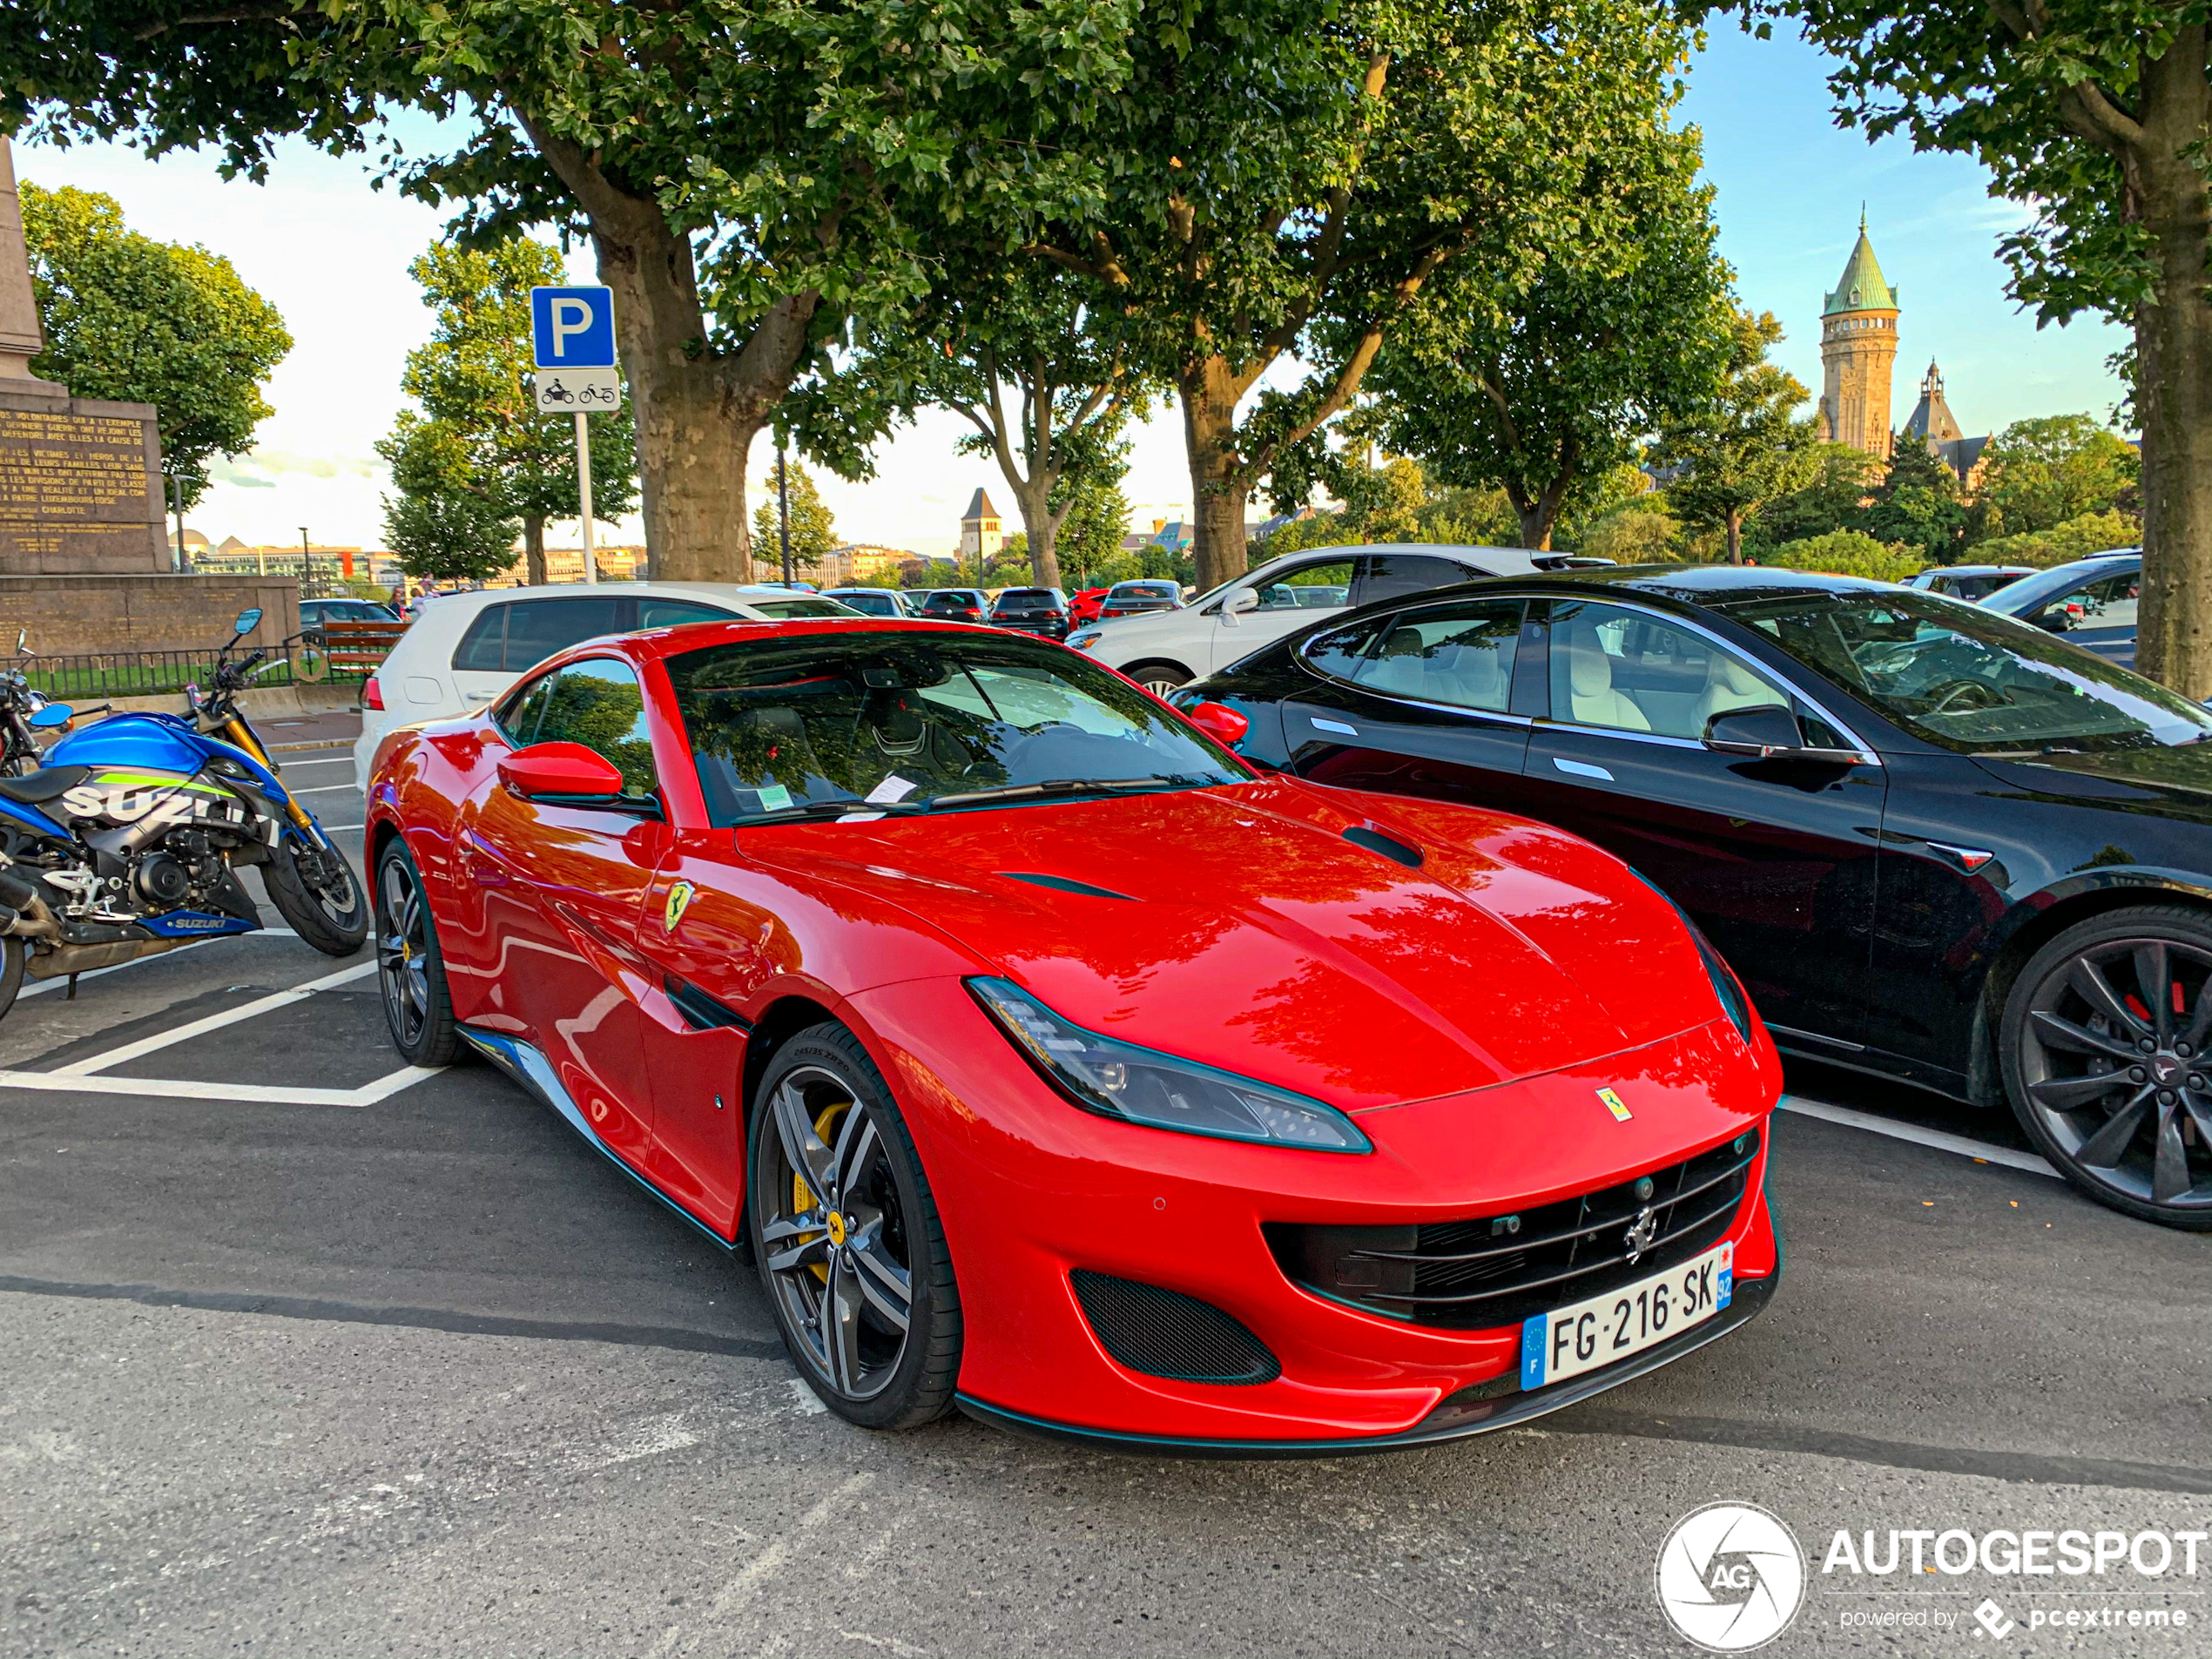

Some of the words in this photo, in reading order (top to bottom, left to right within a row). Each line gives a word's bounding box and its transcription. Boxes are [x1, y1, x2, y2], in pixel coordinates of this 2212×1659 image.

[551, 298, 593, 357] P
[16, 412, 69, 423] VOLONTAIRES
[47, 423, 78, 432] GUERRE
[128, 428, 143, 437] LES
[46, 432, 65, 441] AVEC
[69, 434, 92, 442] ELLES
[107, 436, 131, 445] CAUSE
[133, 437, 143, 446] DE
[33, 449, 70, 459] VICTIMES
[20, 457, 31, 466] DE
[34, 459, 60, 468] LEURS
[42, 468, 55, 476] ILS
[10, 475, 25, 484] LES
[28, 476, 66, 485] DIVISIONS
[22, 485, 38, 494] UNE
[11, 494, 37, 502] PATRIE
[41, 506, 85, 515] CHARLOTTE
[175, 919, 226, 929] SUZUKI
[1717, 1276, 1731, 1300] 92
[1530, 1359, 1538, 1374] F
